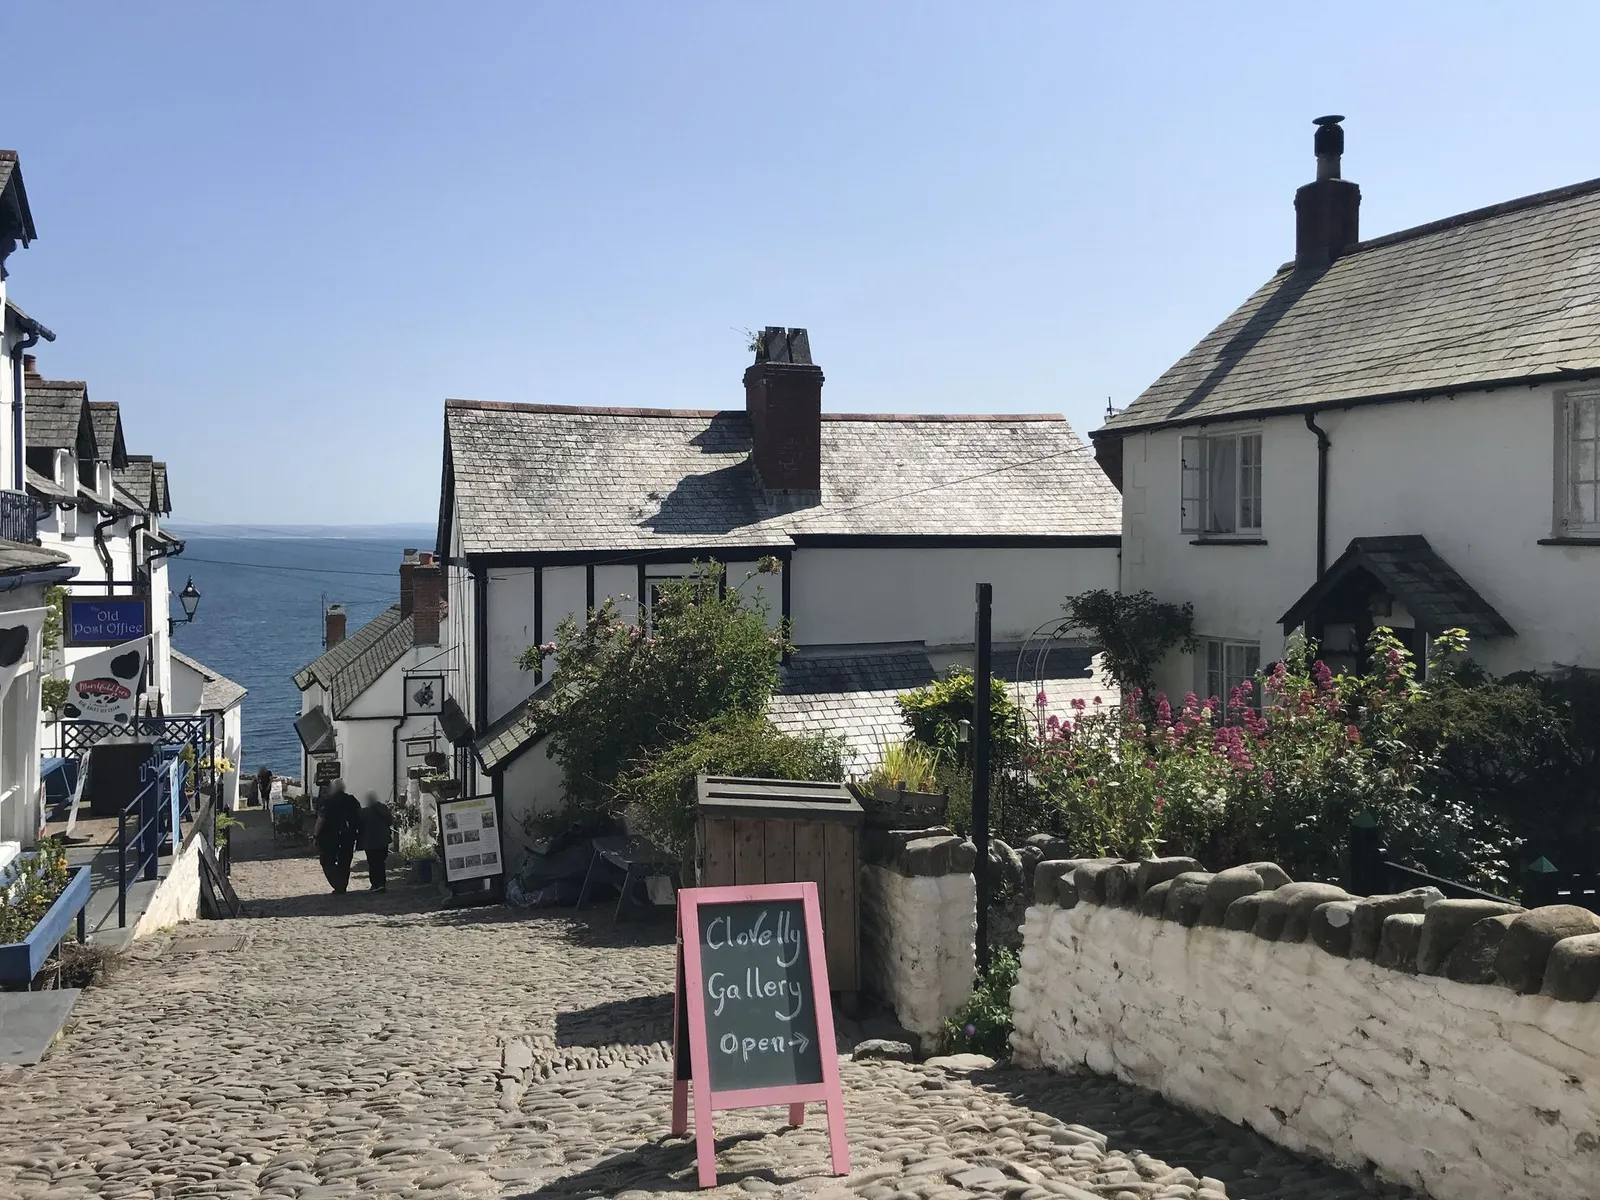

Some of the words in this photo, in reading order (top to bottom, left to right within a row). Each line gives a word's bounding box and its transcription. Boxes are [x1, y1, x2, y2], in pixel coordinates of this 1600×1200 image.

[74, 624, 103, 636] Post
[107, 623, 143, 635] Office
[97, 611, 119, 621] Old
[706, 910, 801, 968] Clovelly
[708, 967, 803, 1021] Gallery
[719, 1032, 786, 1062] Open
